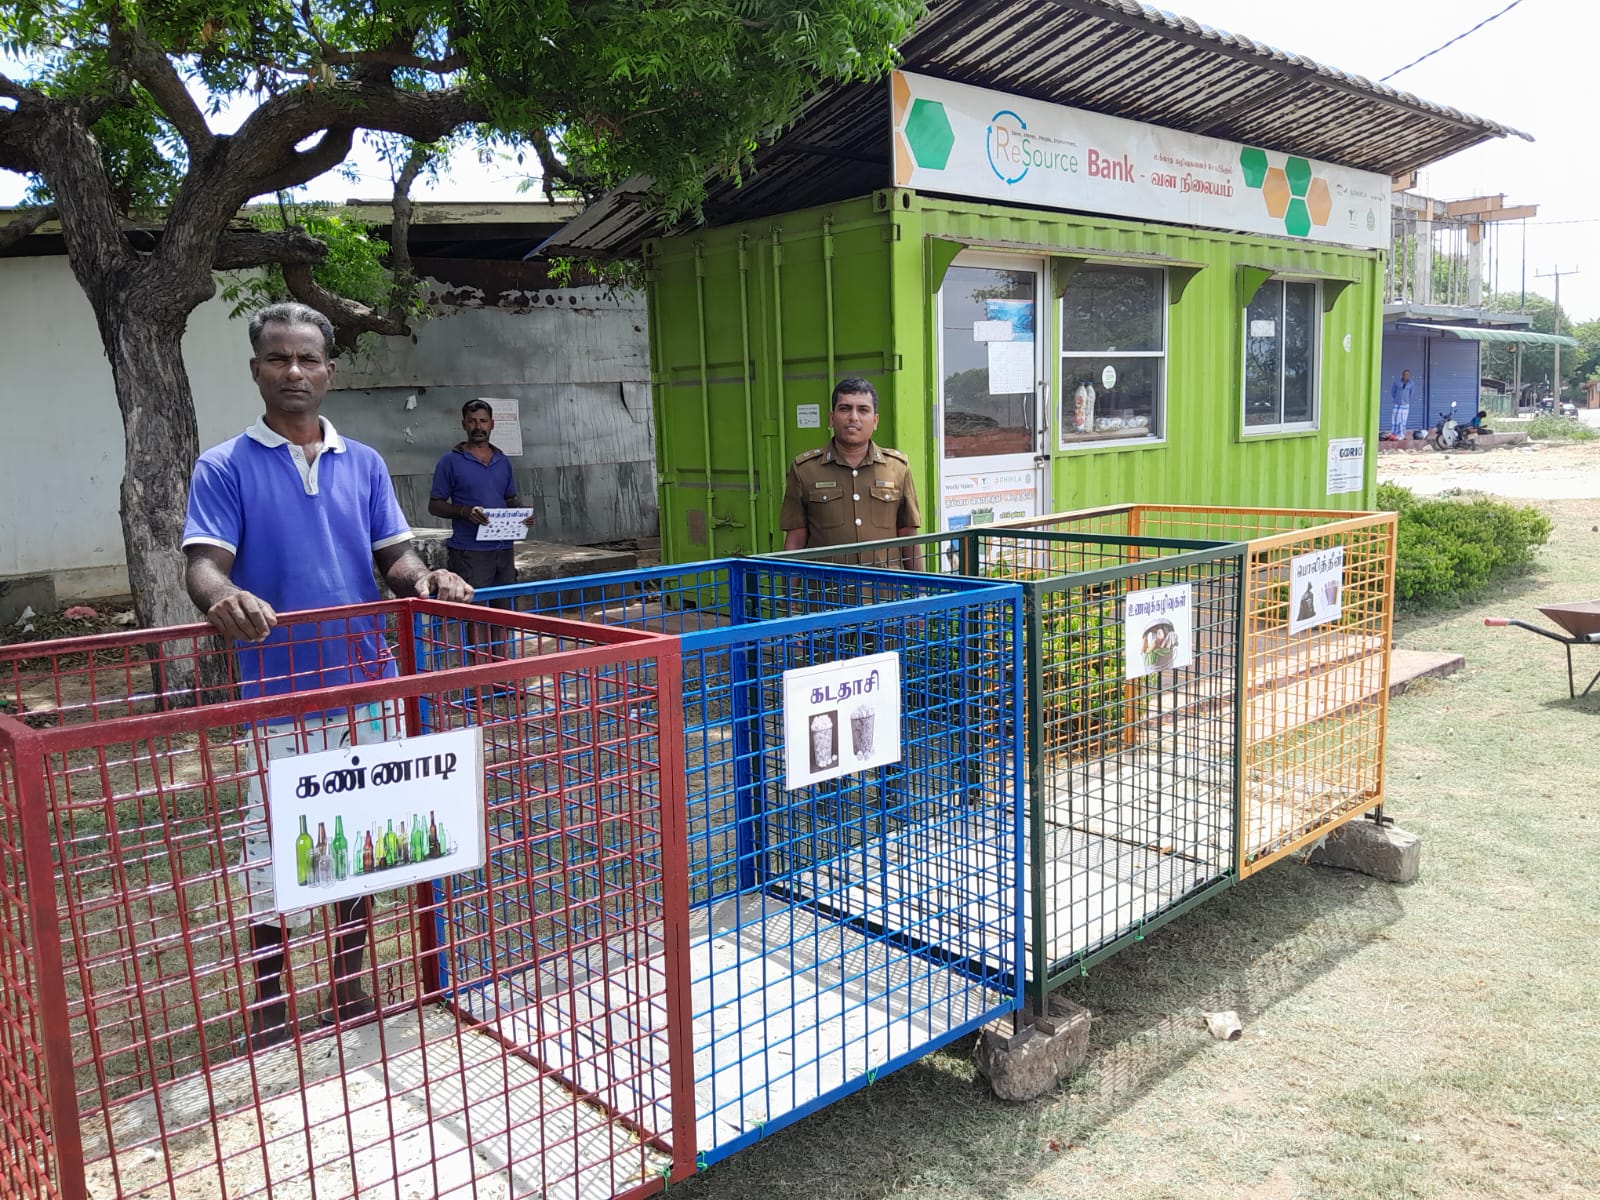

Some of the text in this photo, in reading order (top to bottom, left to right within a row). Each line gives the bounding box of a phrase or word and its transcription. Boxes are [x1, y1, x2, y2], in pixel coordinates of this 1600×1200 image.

[996, 126, 1078, 173] ReSource
[1087, 148, 1135, 183] Bank
[1151, 171, 1177, 189] வள
[1180, 172, 1233, 197] நிலையம்
[1297, 551, 1341, 577] பொலித்தீன்
[1128, 590, 1186, 616] உணவுக்கழிவுகள்
[810, 669, 879, 704] கடதாசி
[296, 753, 457, 799] கண்ணாடி
